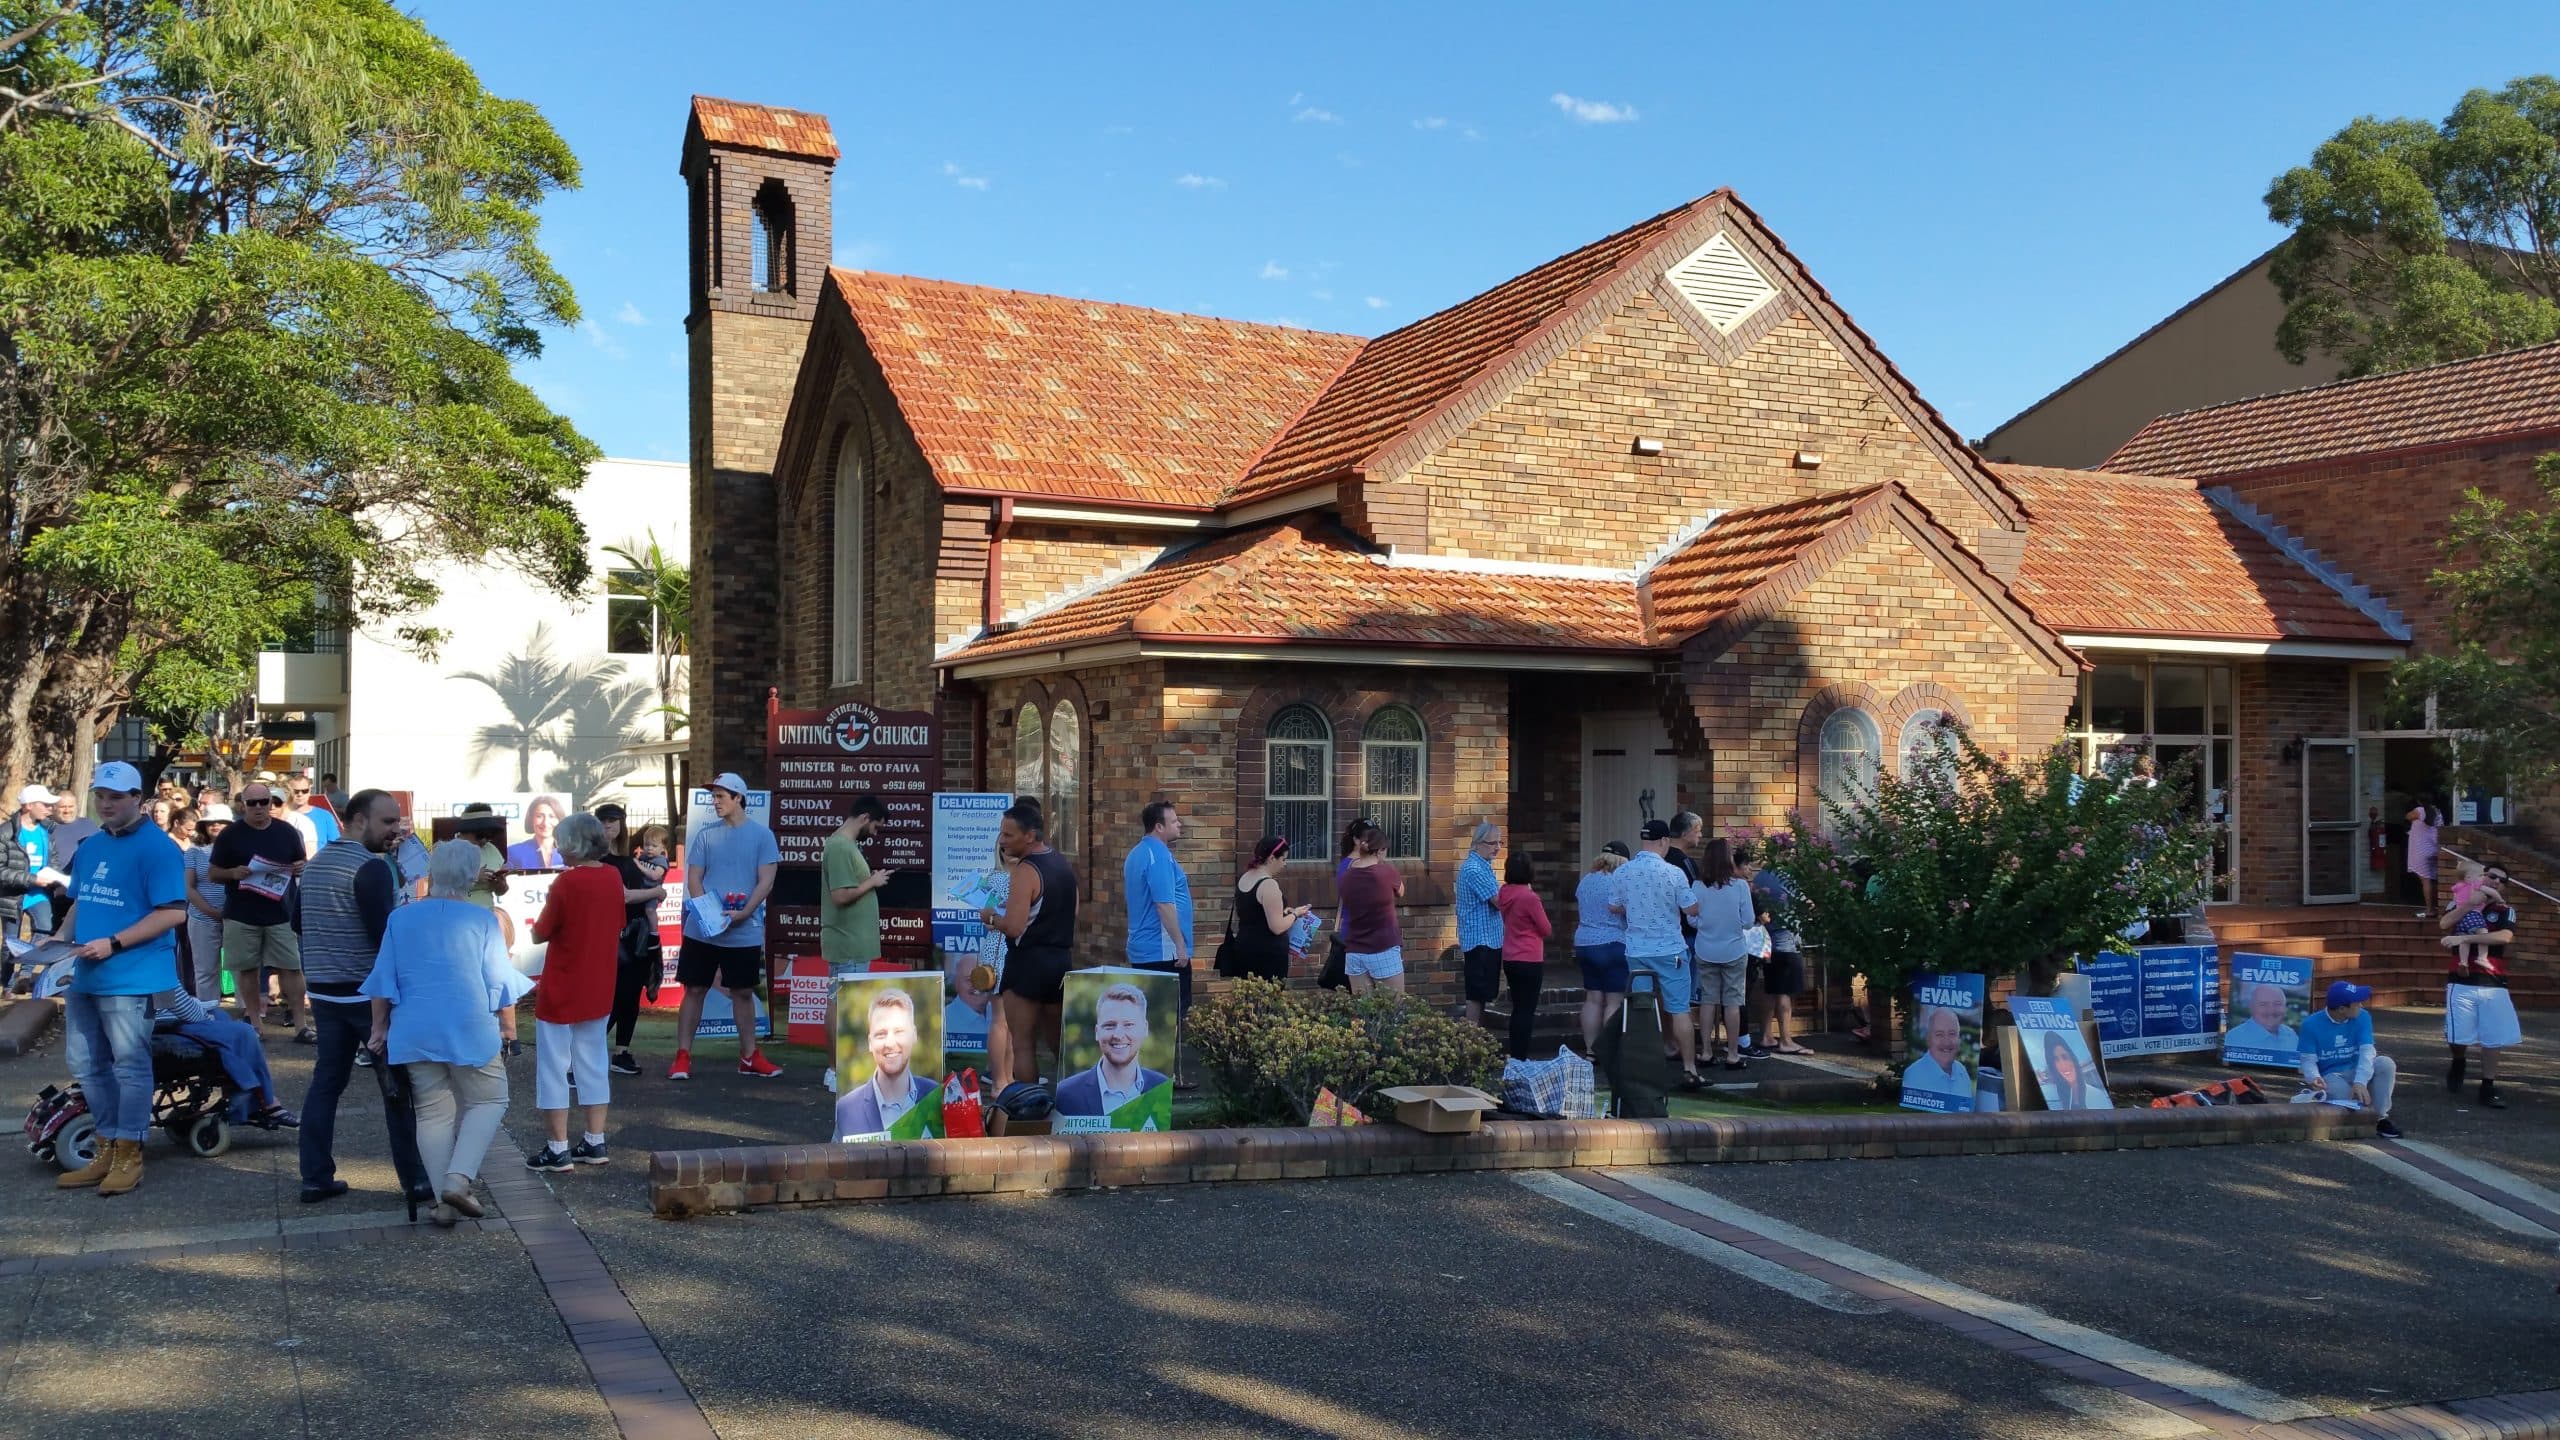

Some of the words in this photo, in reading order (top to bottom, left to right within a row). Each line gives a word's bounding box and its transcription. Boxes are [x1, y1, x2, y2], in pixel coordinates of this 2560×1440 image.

[826, 703, 879, 725] SUTHERLAND
[779, 725, 832, 744] UNITING
[873, 726, 928, 745] CHURCH
[780, 762, 835, 772] MINISTER
[859, 763, 882, 773] OTO
[885, 763, 920, 773] FAIVA
[780, 779, 833, 789] SUTHERLAND
[839, 780, 870, 789] LOFTUS
[907, 781, 925, 790] 6991
[780, 800, 832, 810] SUNDAY
[941, 797, 1007, 808] DELIVERING
[780, 815, 844, 827] SERVICES
[780, 836, 827, 847] FRIDAY
[884, 838, 909, 847] 5:00
[91, 882, 121, 897] Evans
[936, 910, 956, 919] VOTE
[779, 914, 793, 925] We
[795, 914, 811, 925] Are
[813, 917, 819, 925] a
[890, 916, 924, 929] Church
[965, 924, 983, 935] LEE
[2262, 959, 2282, 970] LEE
[2241, 968, 2300, 984] EVANS
[792, 979, 817, 989] Vote
[1939, 975, 1957, 989] LEE
[791, 994, 827, 1005] Schoo
[1920, 986, 1973, 1008] EVANS
[790, 1011, 810, 1021] not
[2018, 1013, 2075, 1030] PETINOS
[2112, 1042, 2138, 1053] LIBERAL
[2143, 1040, 2160, 1049] VOTE
[2173, 1037, 2200, 1048] LIBERAL
[2203, 1036, 2217, 1045] VOT
[2226, 1051, 2274, 1062] HEATHCOTE
[1903, 1095, 1945, 1109] HEATHCOTE
